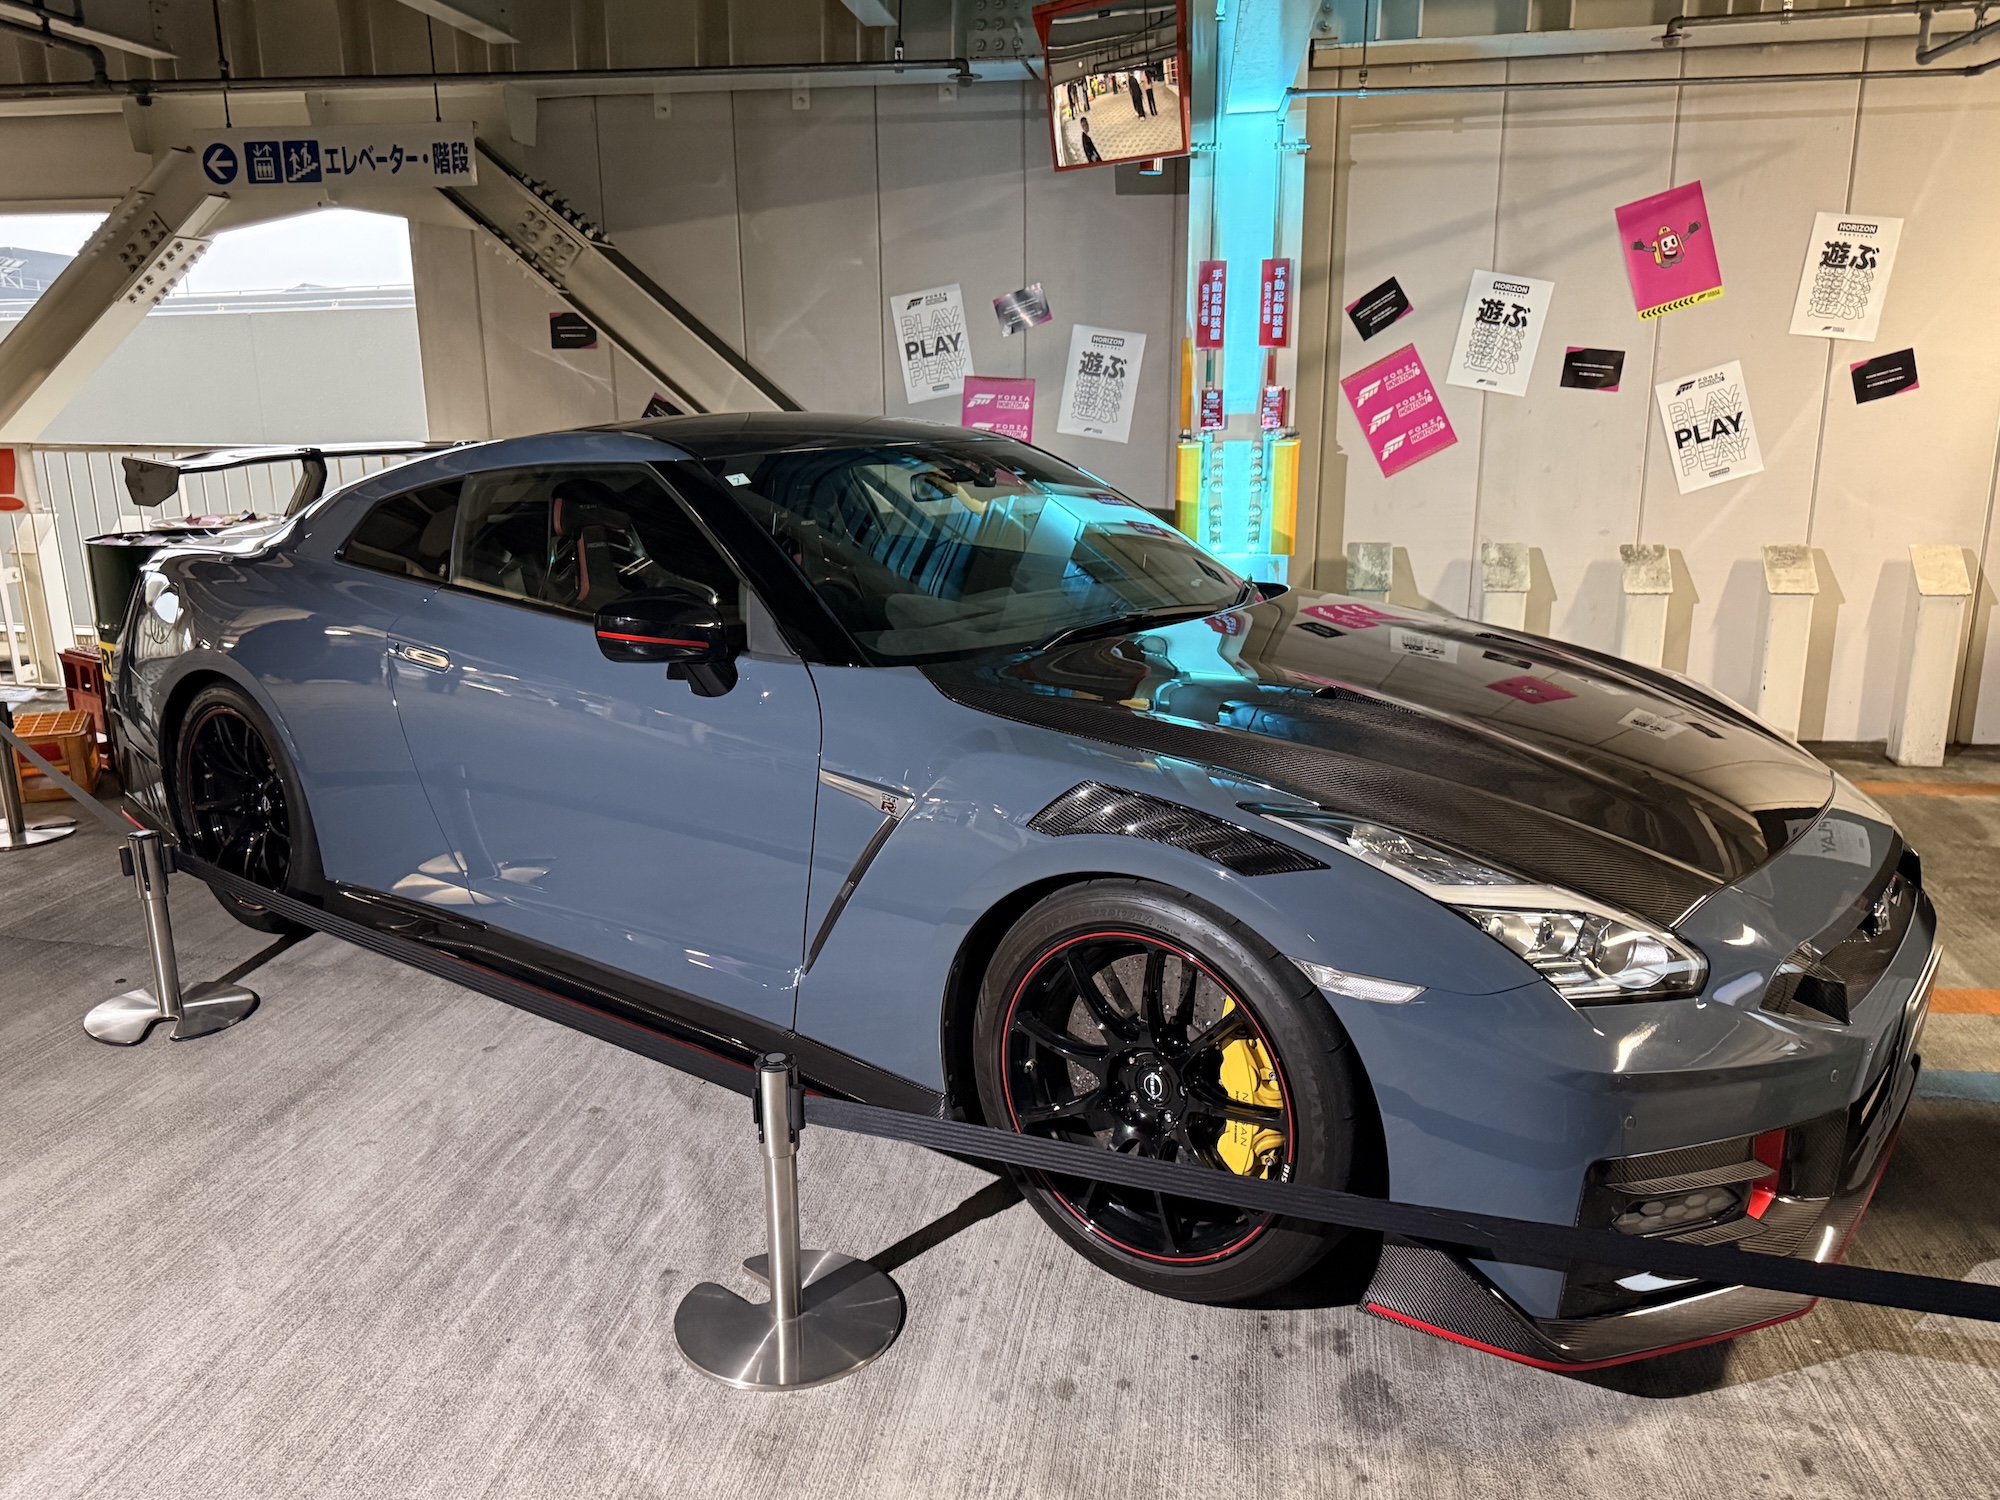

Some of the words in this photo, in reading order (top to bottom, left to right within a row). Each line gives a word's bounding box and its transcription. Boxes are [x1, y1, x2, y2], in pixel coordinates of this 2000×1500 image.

[324, 142, 470, 175] エレベーター・階段
[1839, 222, 1877, 234] HORIZON
[1820, 241, 1880, 270] 遊ぶ
[1494, 282, 1529, 294] HORIZON
[1210, 269, 1223, 340] 手動起動装置
[1272, 267, 1285, 339] 手動起動装置
[1476, 298, 1531, 328] 遊ぶ
[905, 332, 962, 361] PLAY
[1093, 335, 1124, 346] HORIZON
[1079, 351, 1127, 379] 遊ぶ
[1383, 362, 1418, 383] FORZA
[1396, 389, 1431, 410] FORZA
[1408, 416, 1443, 437] FORZA
[1675, 411, 1743, 449] PLAY
